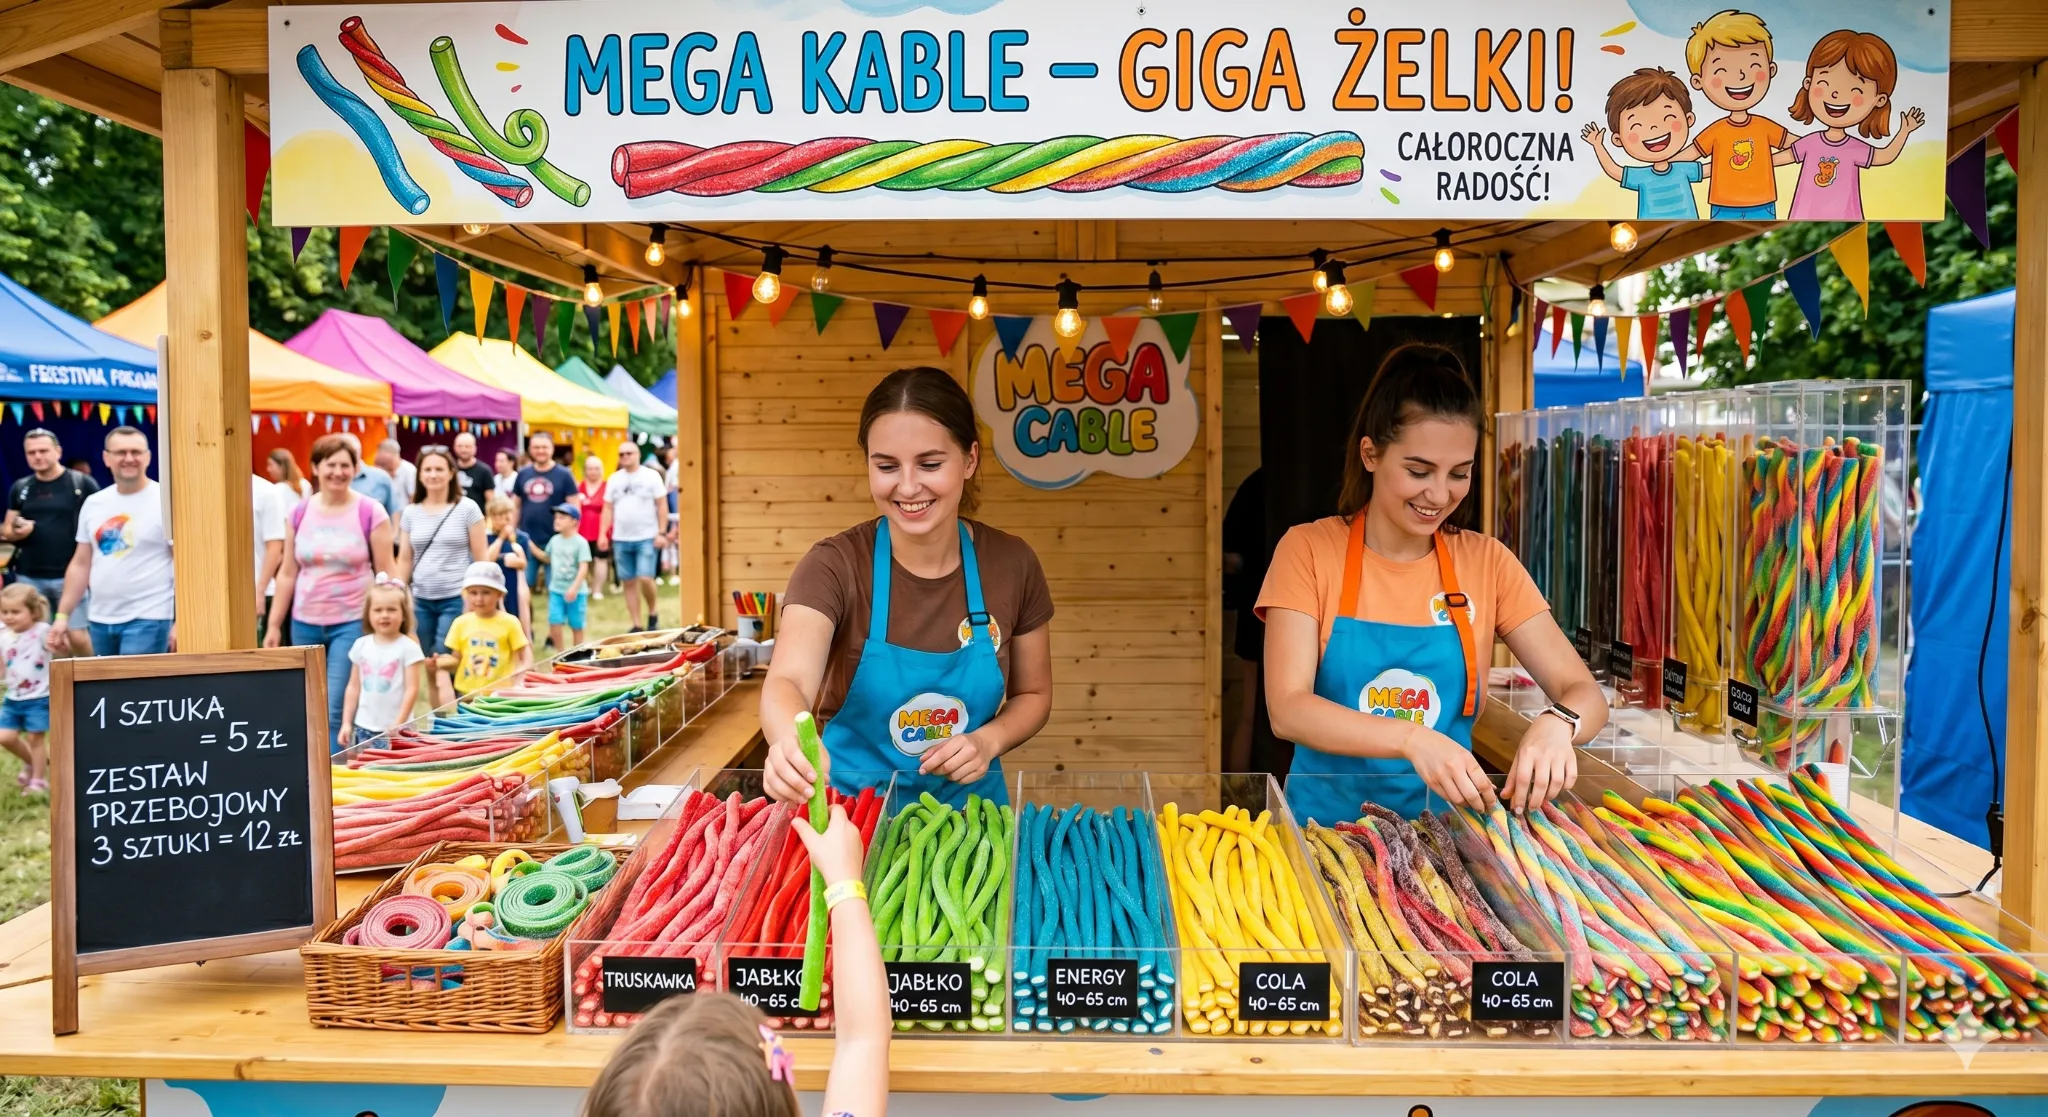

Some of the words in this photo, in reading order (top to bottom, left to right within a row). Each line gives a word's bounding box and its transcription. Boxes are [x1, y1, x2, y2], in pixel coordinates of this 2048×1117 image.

[565, 31, 773, 116] MEGA
[801, 30, 1029, 114] KABLE
[1118, 27, 1305, 112] GIGA
[1332, 7, 1575, 112] ŻELKI!
[1398, 131, 1574, 162] CAŁOROCZNA
[1437, 165, 1550, 202] RADOŚĆ!
[994, 341, 1170, 412] MEGA
[1014, 405, 1158, 458] CABLE
[1368, 687, 1430, 710] MEGA
[89, 697, 106, 729] 1
[118, 695, 225, 727] SZTUKA
[898, 708, 959, 729] MEGA
[227, 721, 249, 752] 5
[901, 725, 953, 743] CABLE
[86, 761, 208, 795] ZESTAW
[88, 787, 288, 827] PRZEBOJOWY
[91, 835, 113, 865] 3
[122, 832, 210, 860] SZTUKI
[240, 820, 273, 851] 12
[604, 971, 696, 990] TRUSKAWKA
[889, 973, 963, 994] JABŁKO
[1055, 968, 1126, 986] ENERGY
[1256, 973, 1306, 990] COLA
[1491, 971, 1539, 987] COLA
[890, 998, 938, 1013] 40-65
[941, 1003, 962, 1013] cm
[1056, 991, 1104, 1006] 40-65
[1107, 995, 1127, 1006] cm
[1249, 996, 1297, 1011] 40-65
[1300, 1001, 1320, 1011] cm
[1481, 993, 1530, 1008] 40-65
[1533, 998, 1553, 1008] cm
